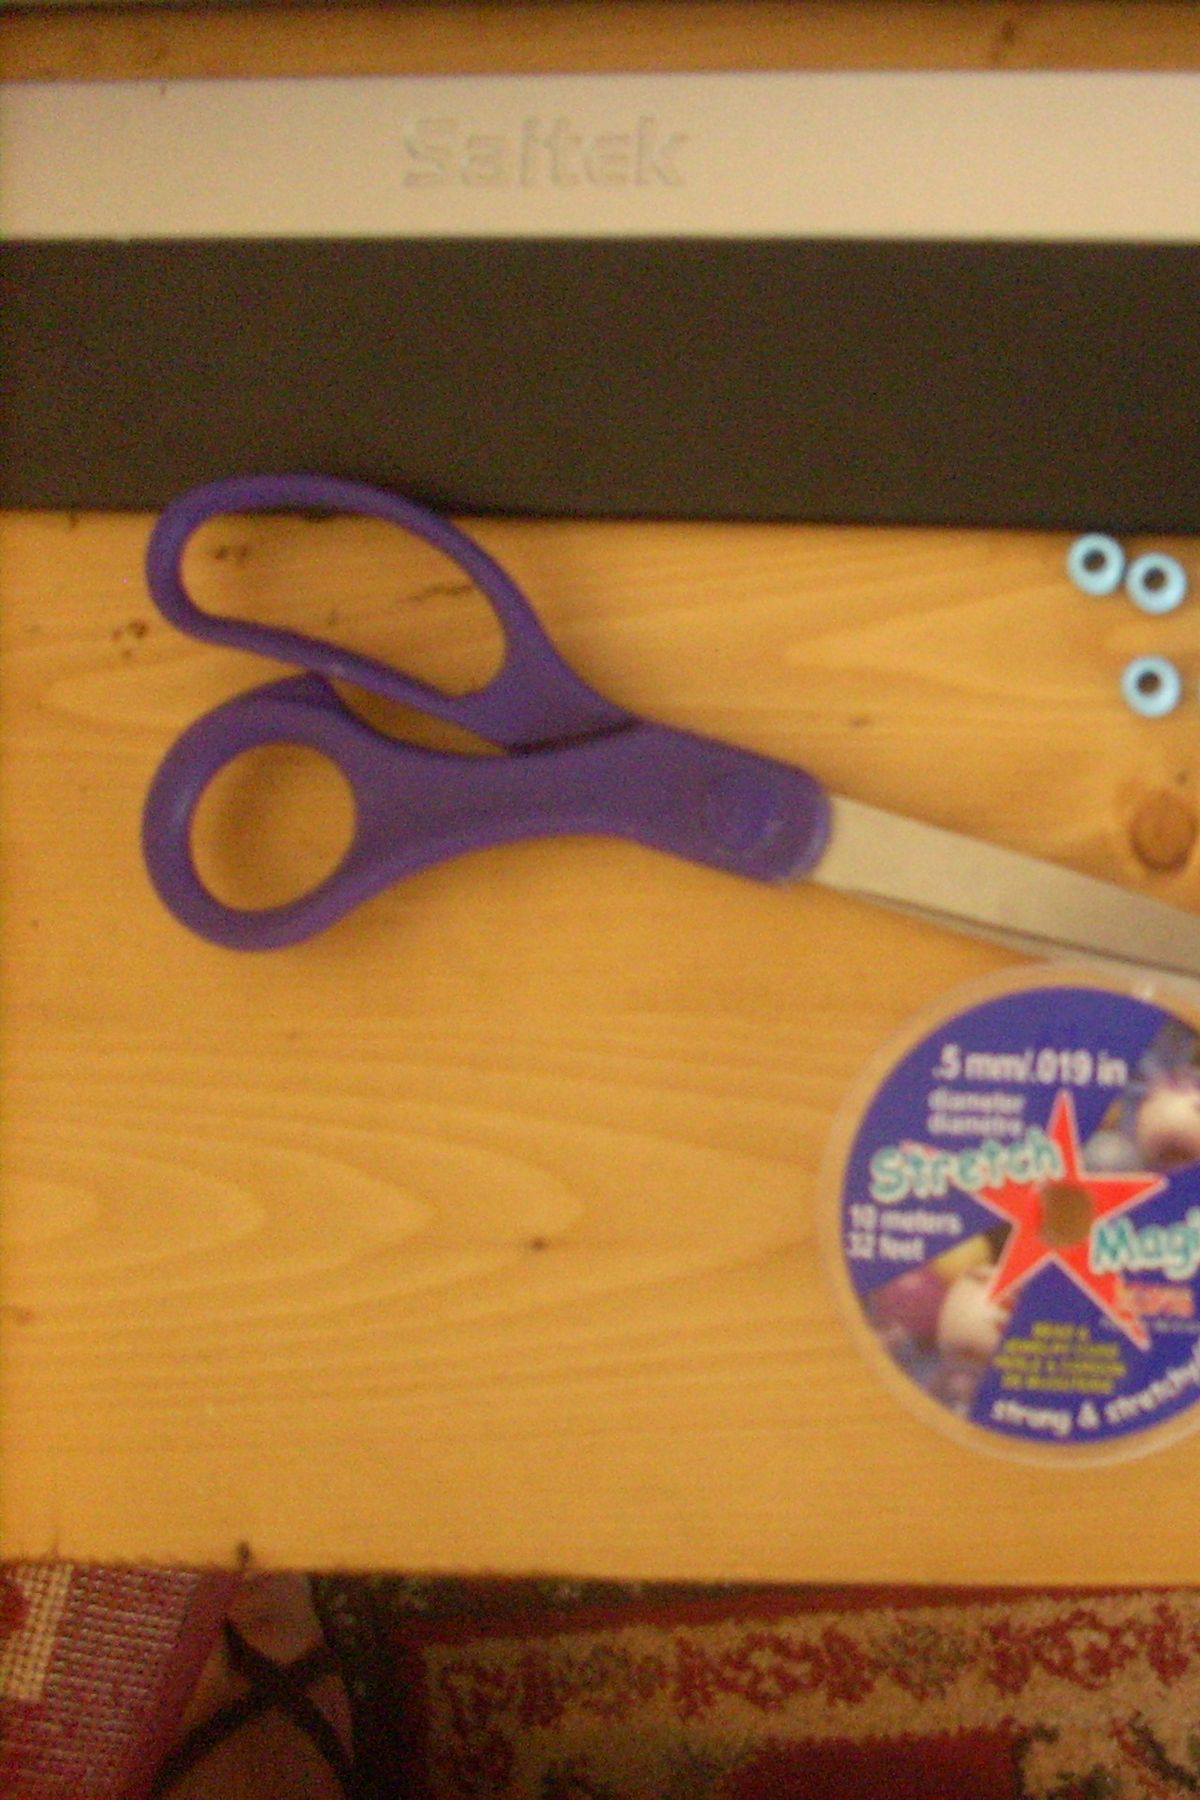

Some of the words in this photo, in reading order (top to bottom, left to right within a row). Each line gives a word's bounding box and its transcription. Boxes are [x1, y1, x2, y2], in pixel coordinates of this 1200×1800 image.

[403, 114, 690, 188] Saitek
[1096, 1048, 1129, 1087] in
[868, 1125, 1067, 1204] Stretch
[990, 1400, 1073, 1437] strong
[1076, 1400, 1100, 1430] &
